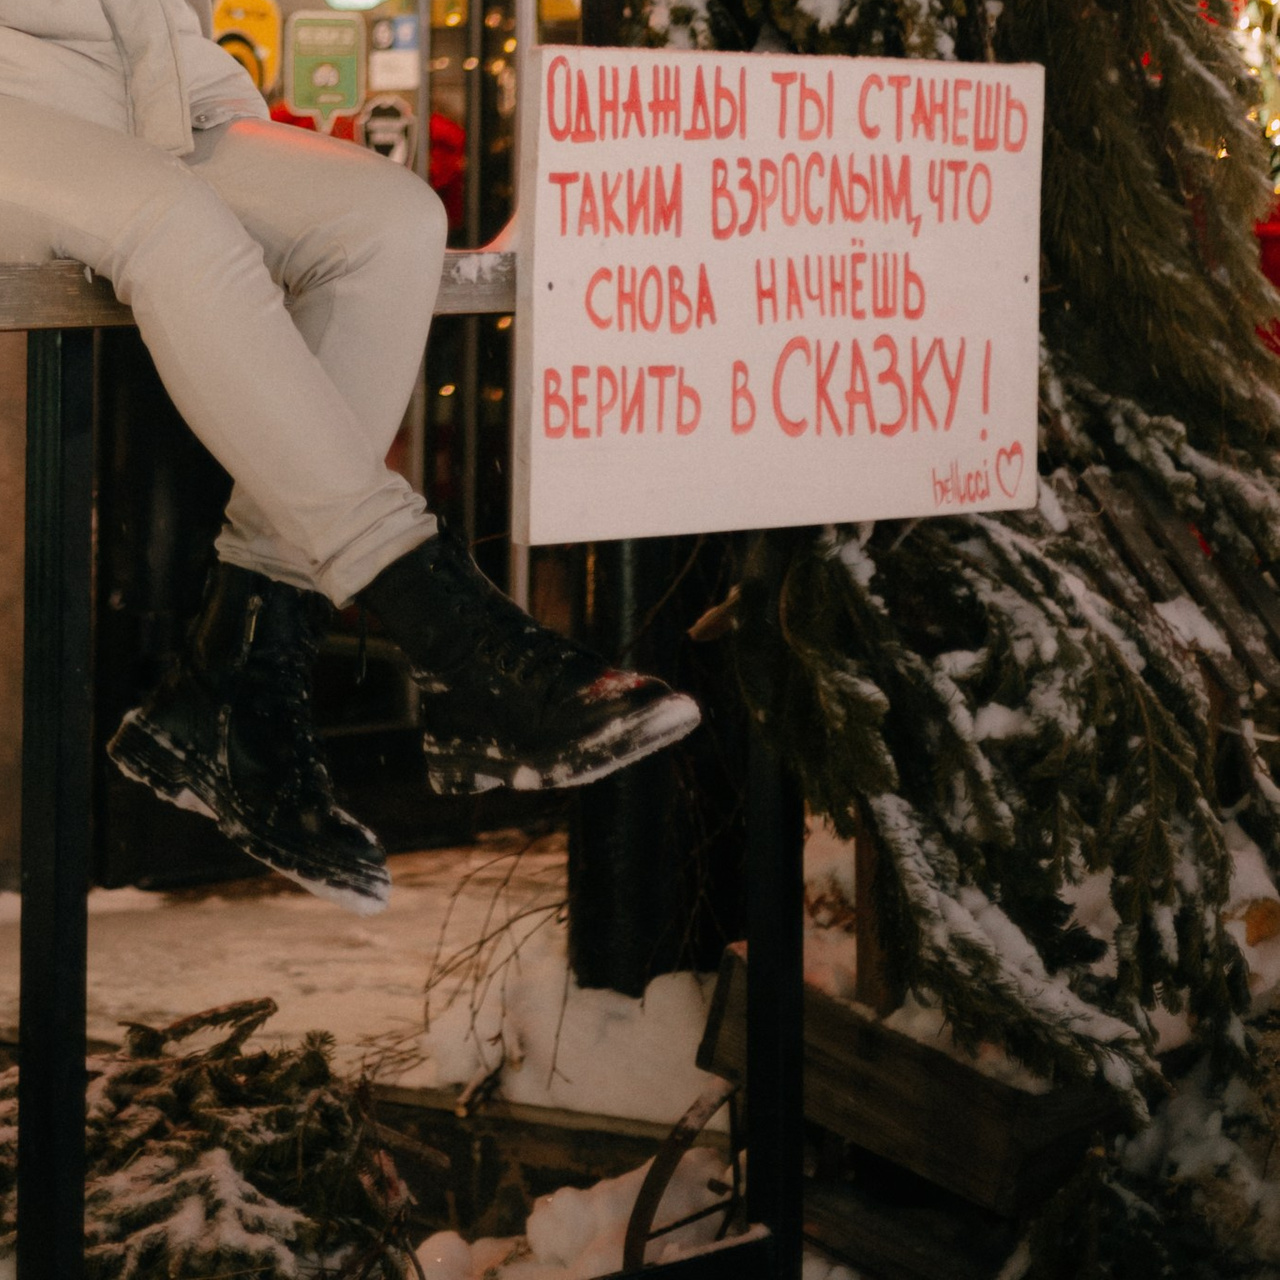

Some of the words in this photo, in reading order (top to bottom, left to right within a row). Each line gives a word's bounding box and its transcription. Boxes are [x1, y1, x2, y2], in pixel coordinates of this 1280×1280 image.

[546, 55, 747, 143] ОДНАЖДЫ
[771, 70, 835, 142] ТЫ
[858, 72, 1029, 153] СТАНЕШЬ
[548, 162, 683, 238] ТАКИМ
[584, 262, 718, 334] СНОВА
[754, 237, 926, 326] НАЧНЁШЬ
[542, 364, 703, 439] ВЕРИТЬ
